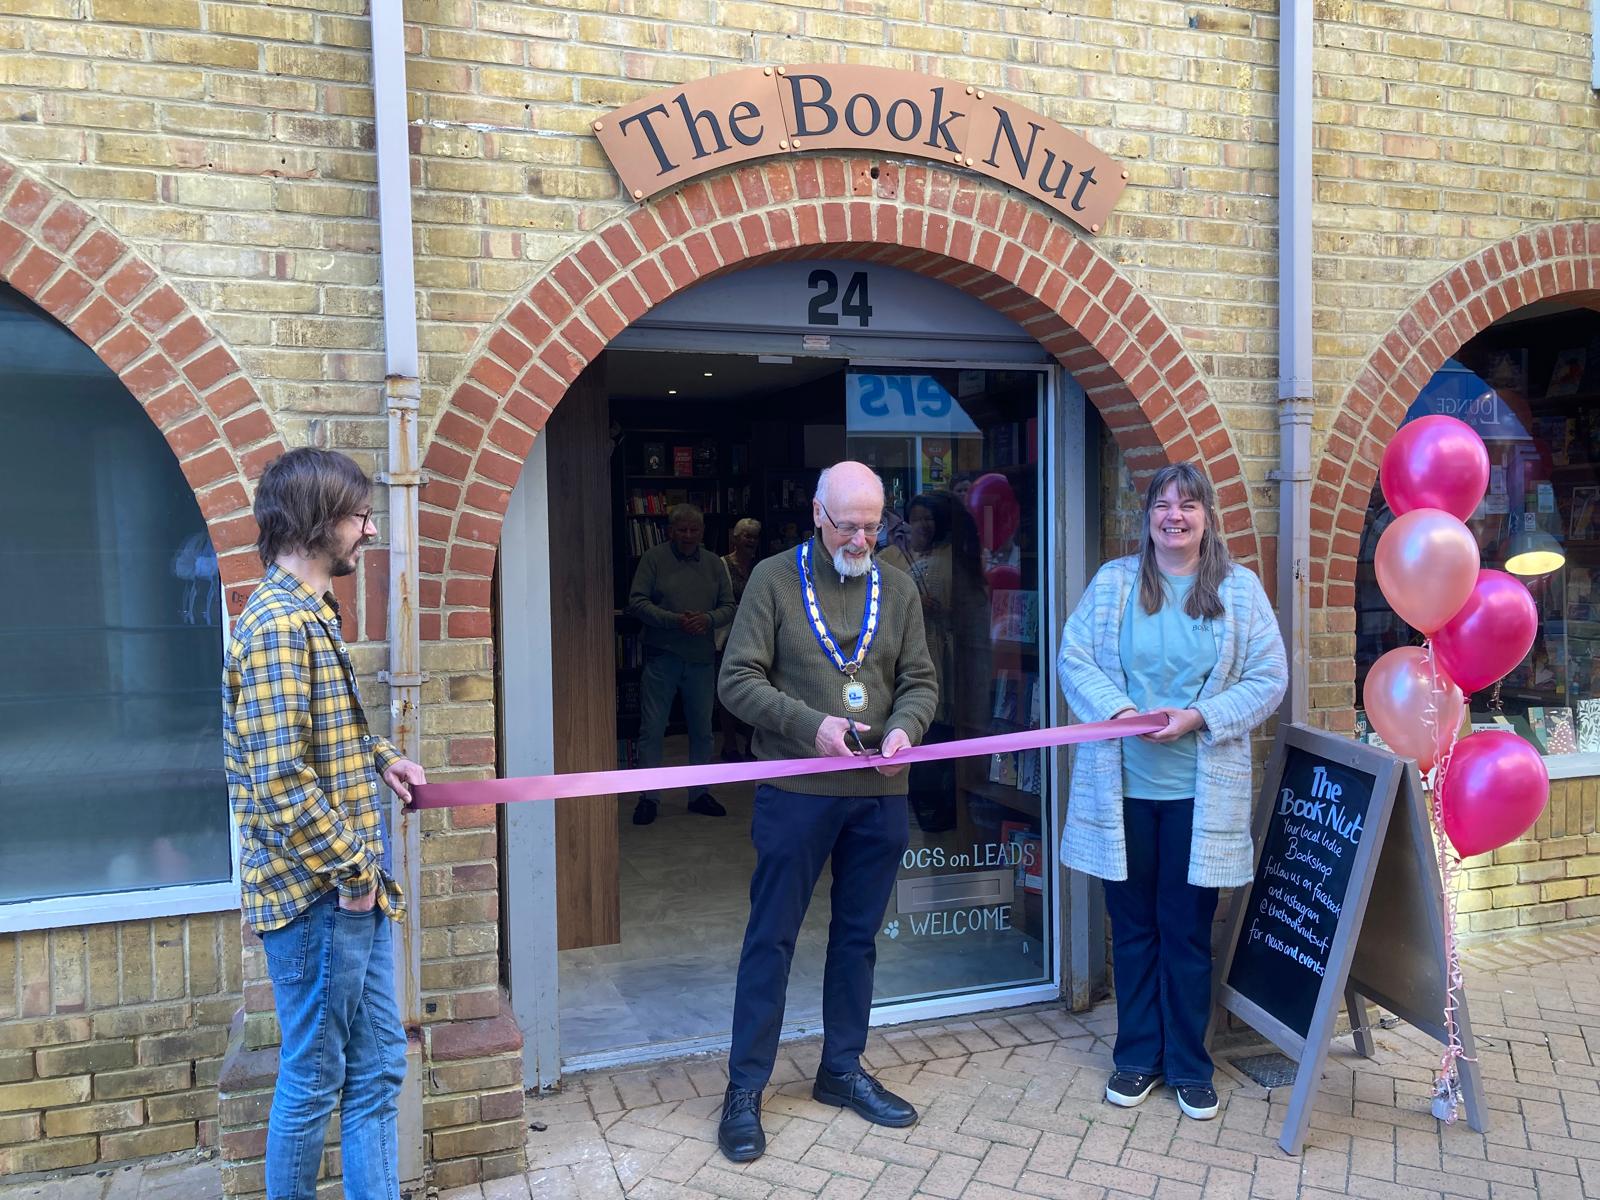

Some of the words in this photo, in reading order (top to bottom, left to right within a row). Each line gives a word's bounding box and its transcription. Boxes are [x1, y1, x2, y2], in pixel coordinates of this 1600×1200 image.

[619, 92, 765, 177] The
[783, 74, 966, 154] Book
[982, 106, 1098, 212] Nut
[807, 269, 873, 328] 24
[1311, 766, 1343, 803] The
[1325, 803, 1363, 845] Nut
[899, 847, 945, 869] OGS
[950, 854, 970, 867] on
[973, 842, 1036, 866] LEADS
[1285, 836, 1333, 883] Bookshop
[1268, 885, 1283, 899] and
[1290, 873, 1301, 886] us
[1302, 879, 1312, 892] on
[909, 905, 1012, 936] WELCOME
[1264, 933, 1284, 952] news
[1283, 945, 1299, 961] and
[1298, 952, 1326, 977] events
